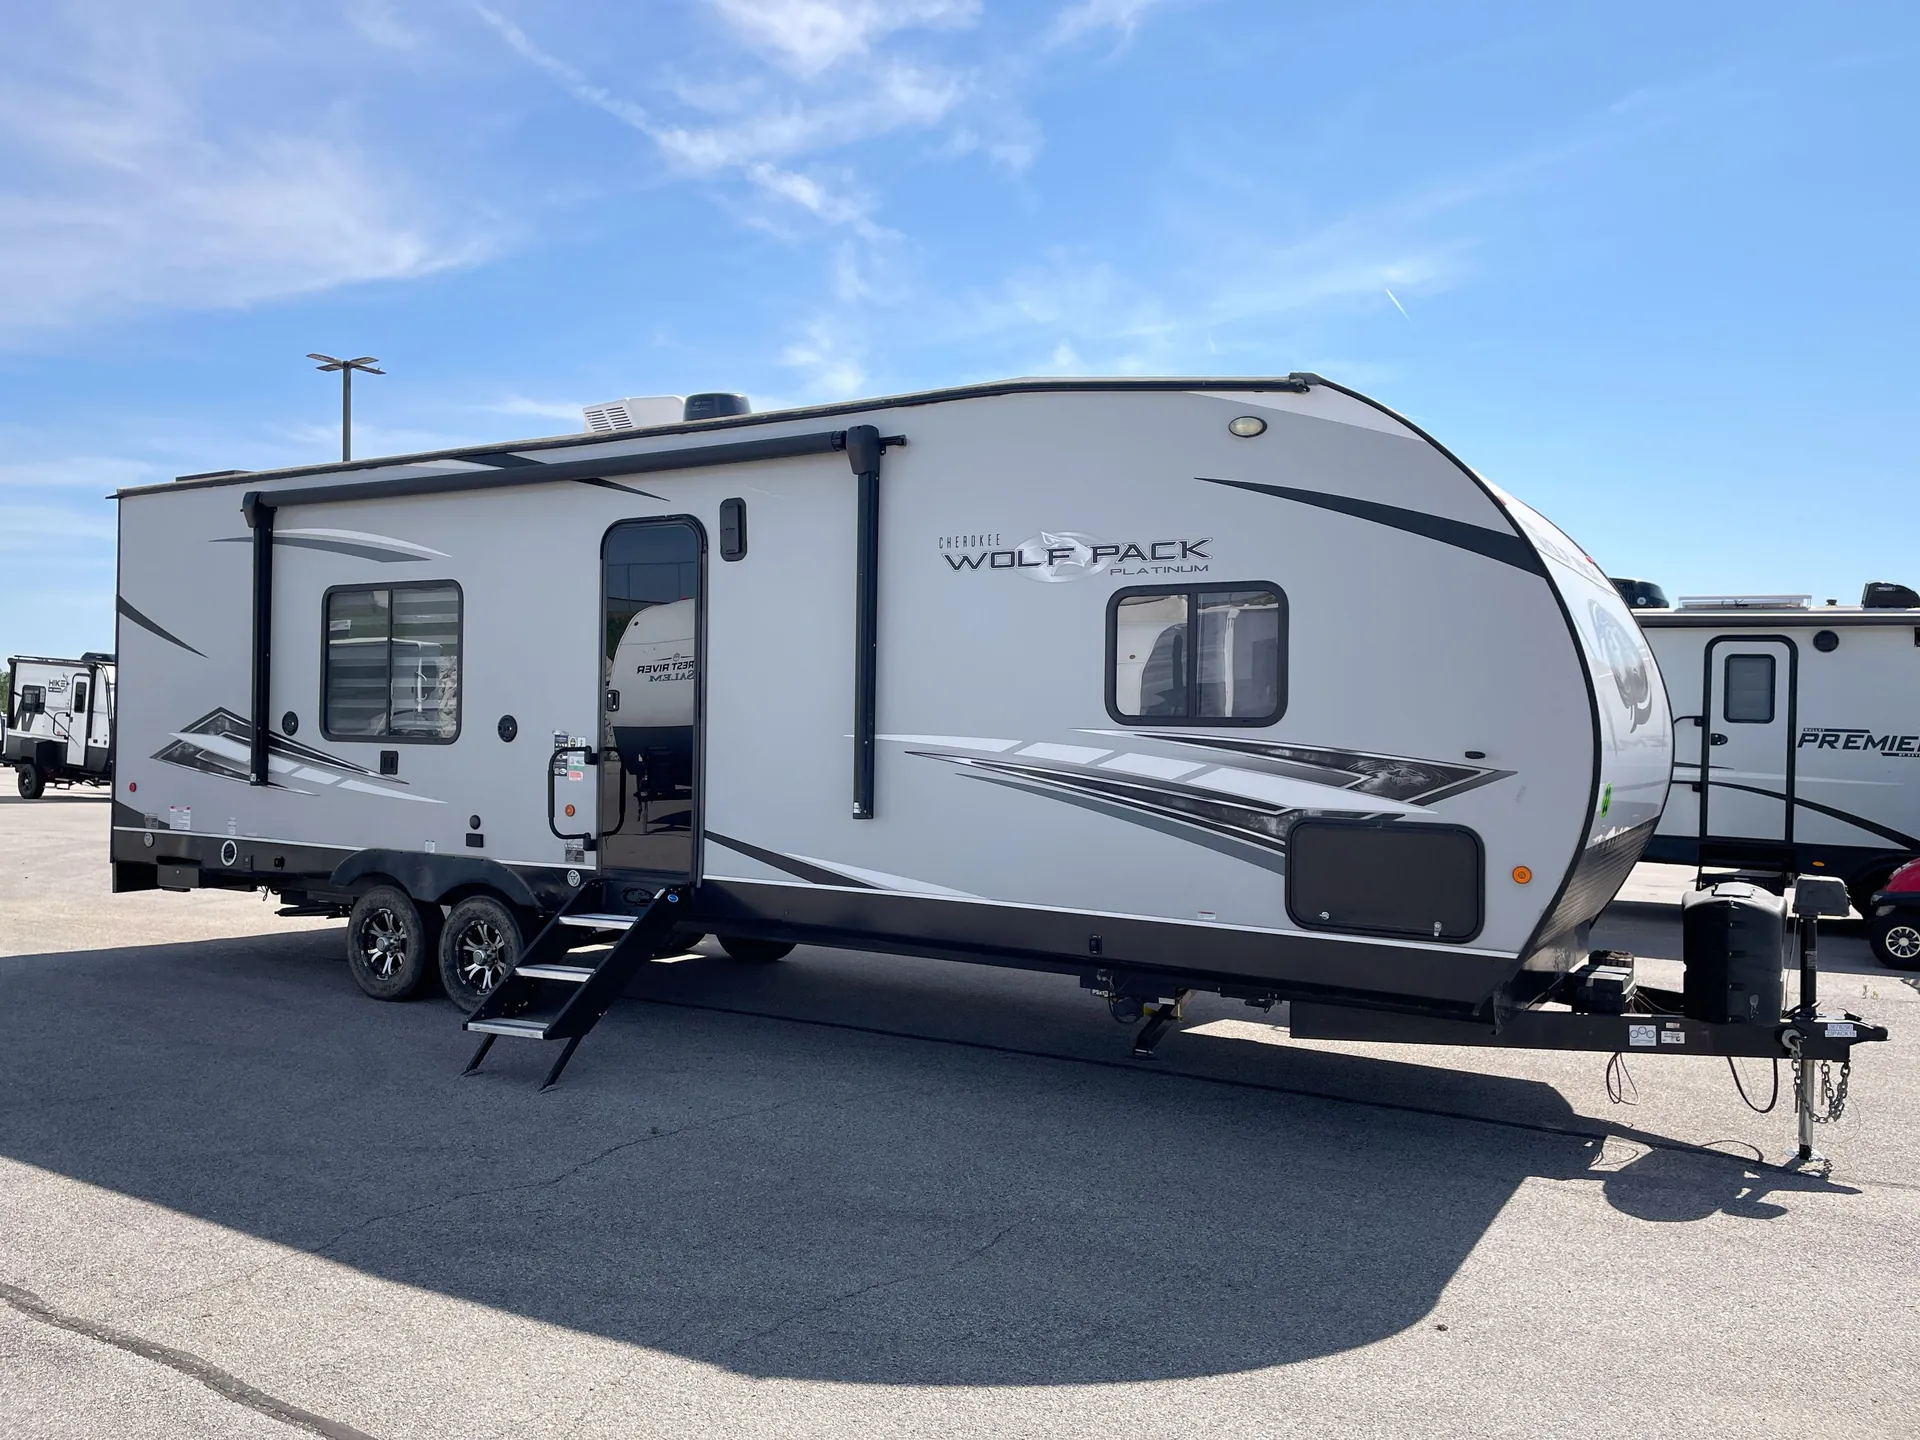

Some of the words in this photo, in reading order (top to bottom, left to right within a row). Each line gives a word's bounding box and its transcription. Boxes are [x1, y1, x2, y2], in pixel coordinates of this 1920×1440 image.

[939, 534, 1000, 549] CHEROKEE
[943, 547, 1075, 571] WOLF
[1087, 538, 1213, 564] PACK
[1110, 564, 1209, 575] PLATINUM
[1797, 732, 1920, 751] PREMIE
